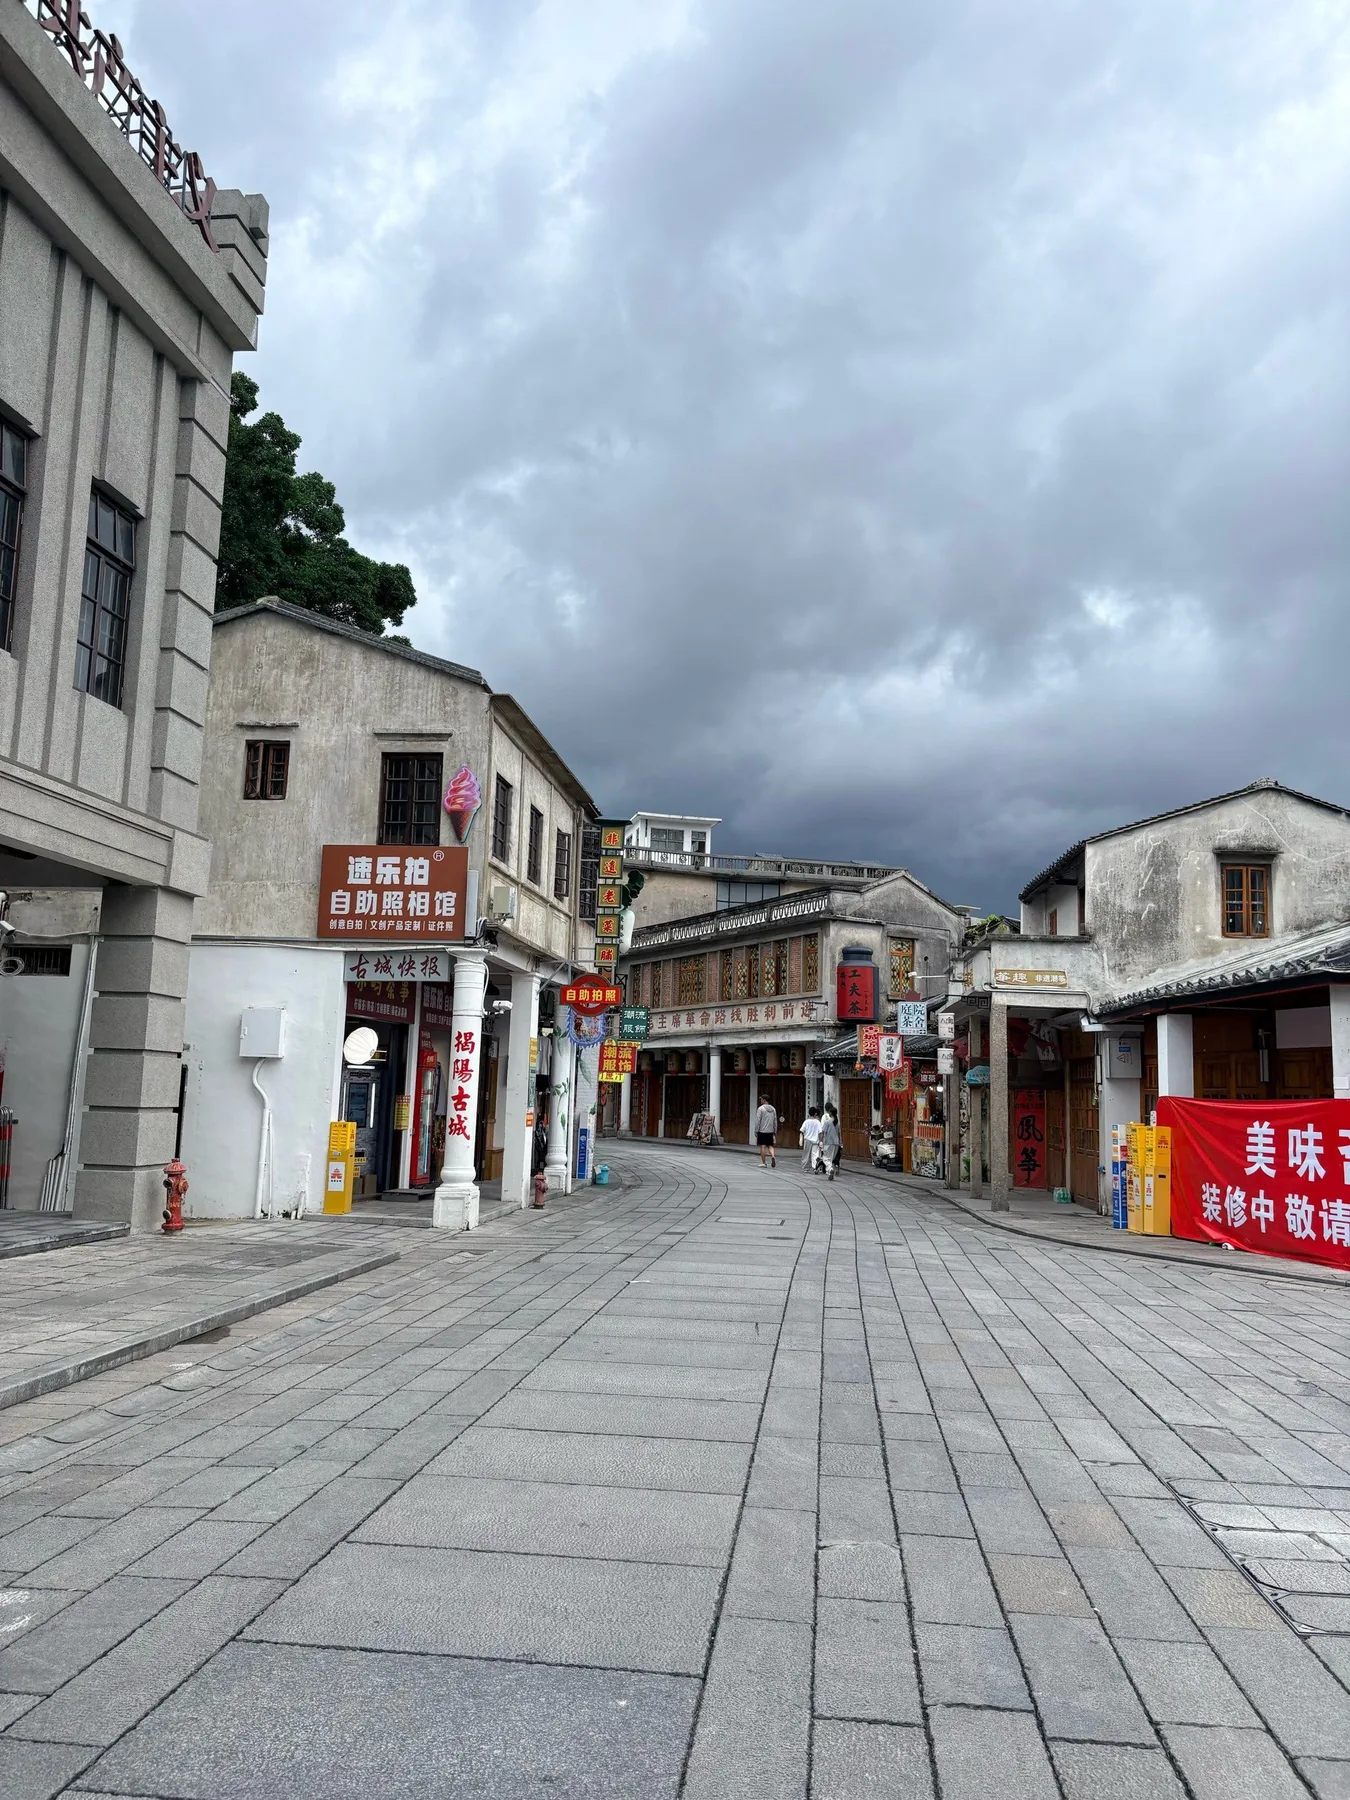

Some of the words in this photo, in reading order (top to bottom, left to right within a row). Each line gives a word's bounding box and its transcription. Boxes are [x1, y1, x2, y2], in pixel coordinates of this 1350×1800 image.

[347, 856, 430, 885] 速乐拍
[330, 889, 457, 917] 自助照相馆
[329, 919, 363, 930] 创意自拍
[369, 920, 421, 931] 文创产品定制
[427, 921, 453, 932] 证件照
[350, 953, 441, 980] 古城快报
[566, 989, 616, 1002] 自助拍照
[848, 969, 863, 1015] 工夫茶
[623, 1010, 647, 1020] 潮流
[901, 1004, 925, 1015] 庭院
[902, 1016, 925, 1028] 茶舍
[603, 1046, 632, 1059] 潮流
[603, 1059, 632, 1072] 服饰
[448, 1030, 476, 1141] 揭陽古城
[1201, 1182, 1350, 1247] 装修中敬请
